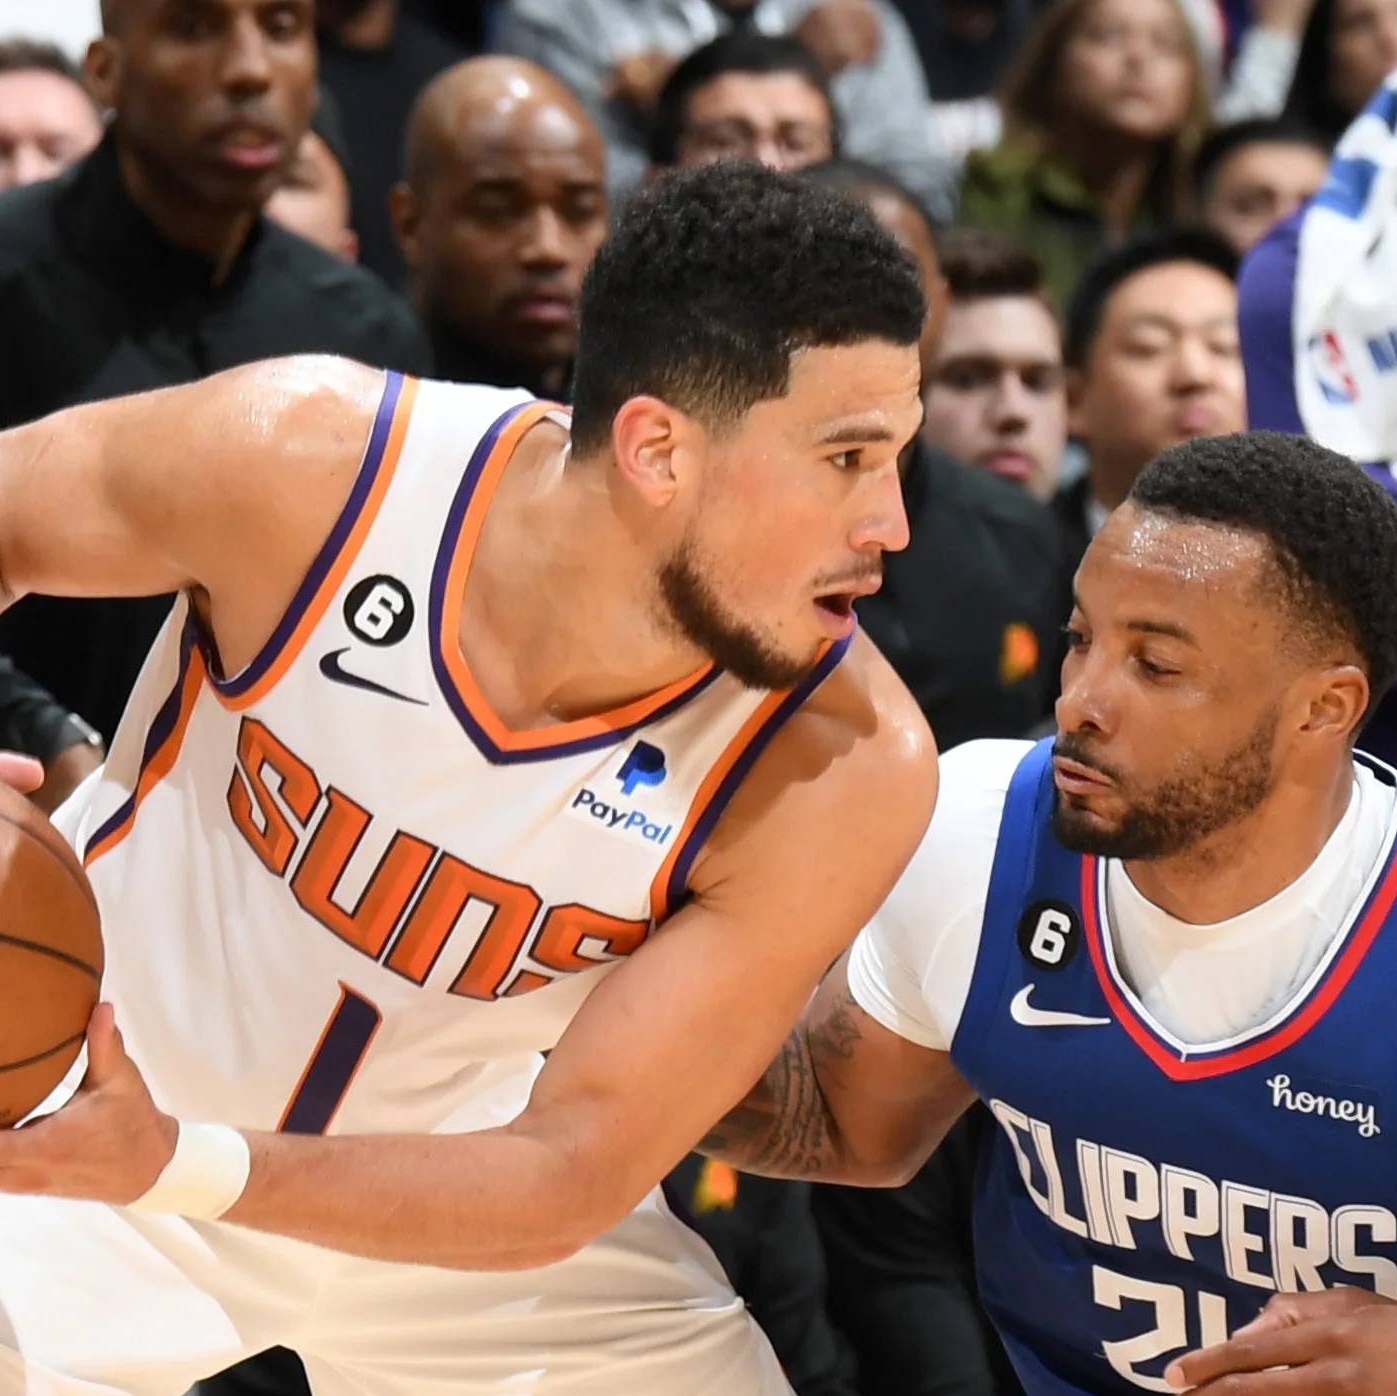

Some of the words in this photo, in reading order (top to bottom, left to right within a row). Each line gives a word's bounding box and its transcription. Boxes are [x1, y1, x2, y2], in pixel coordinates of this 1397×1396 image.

[353, 584, 404, 640] 6
[571, 787, 673, 845] PayPal
[1030, 908, 1071, 964] 6
[277, 979, 383, 1134] 1
[1266, 1074, 1381, 1137] honey
